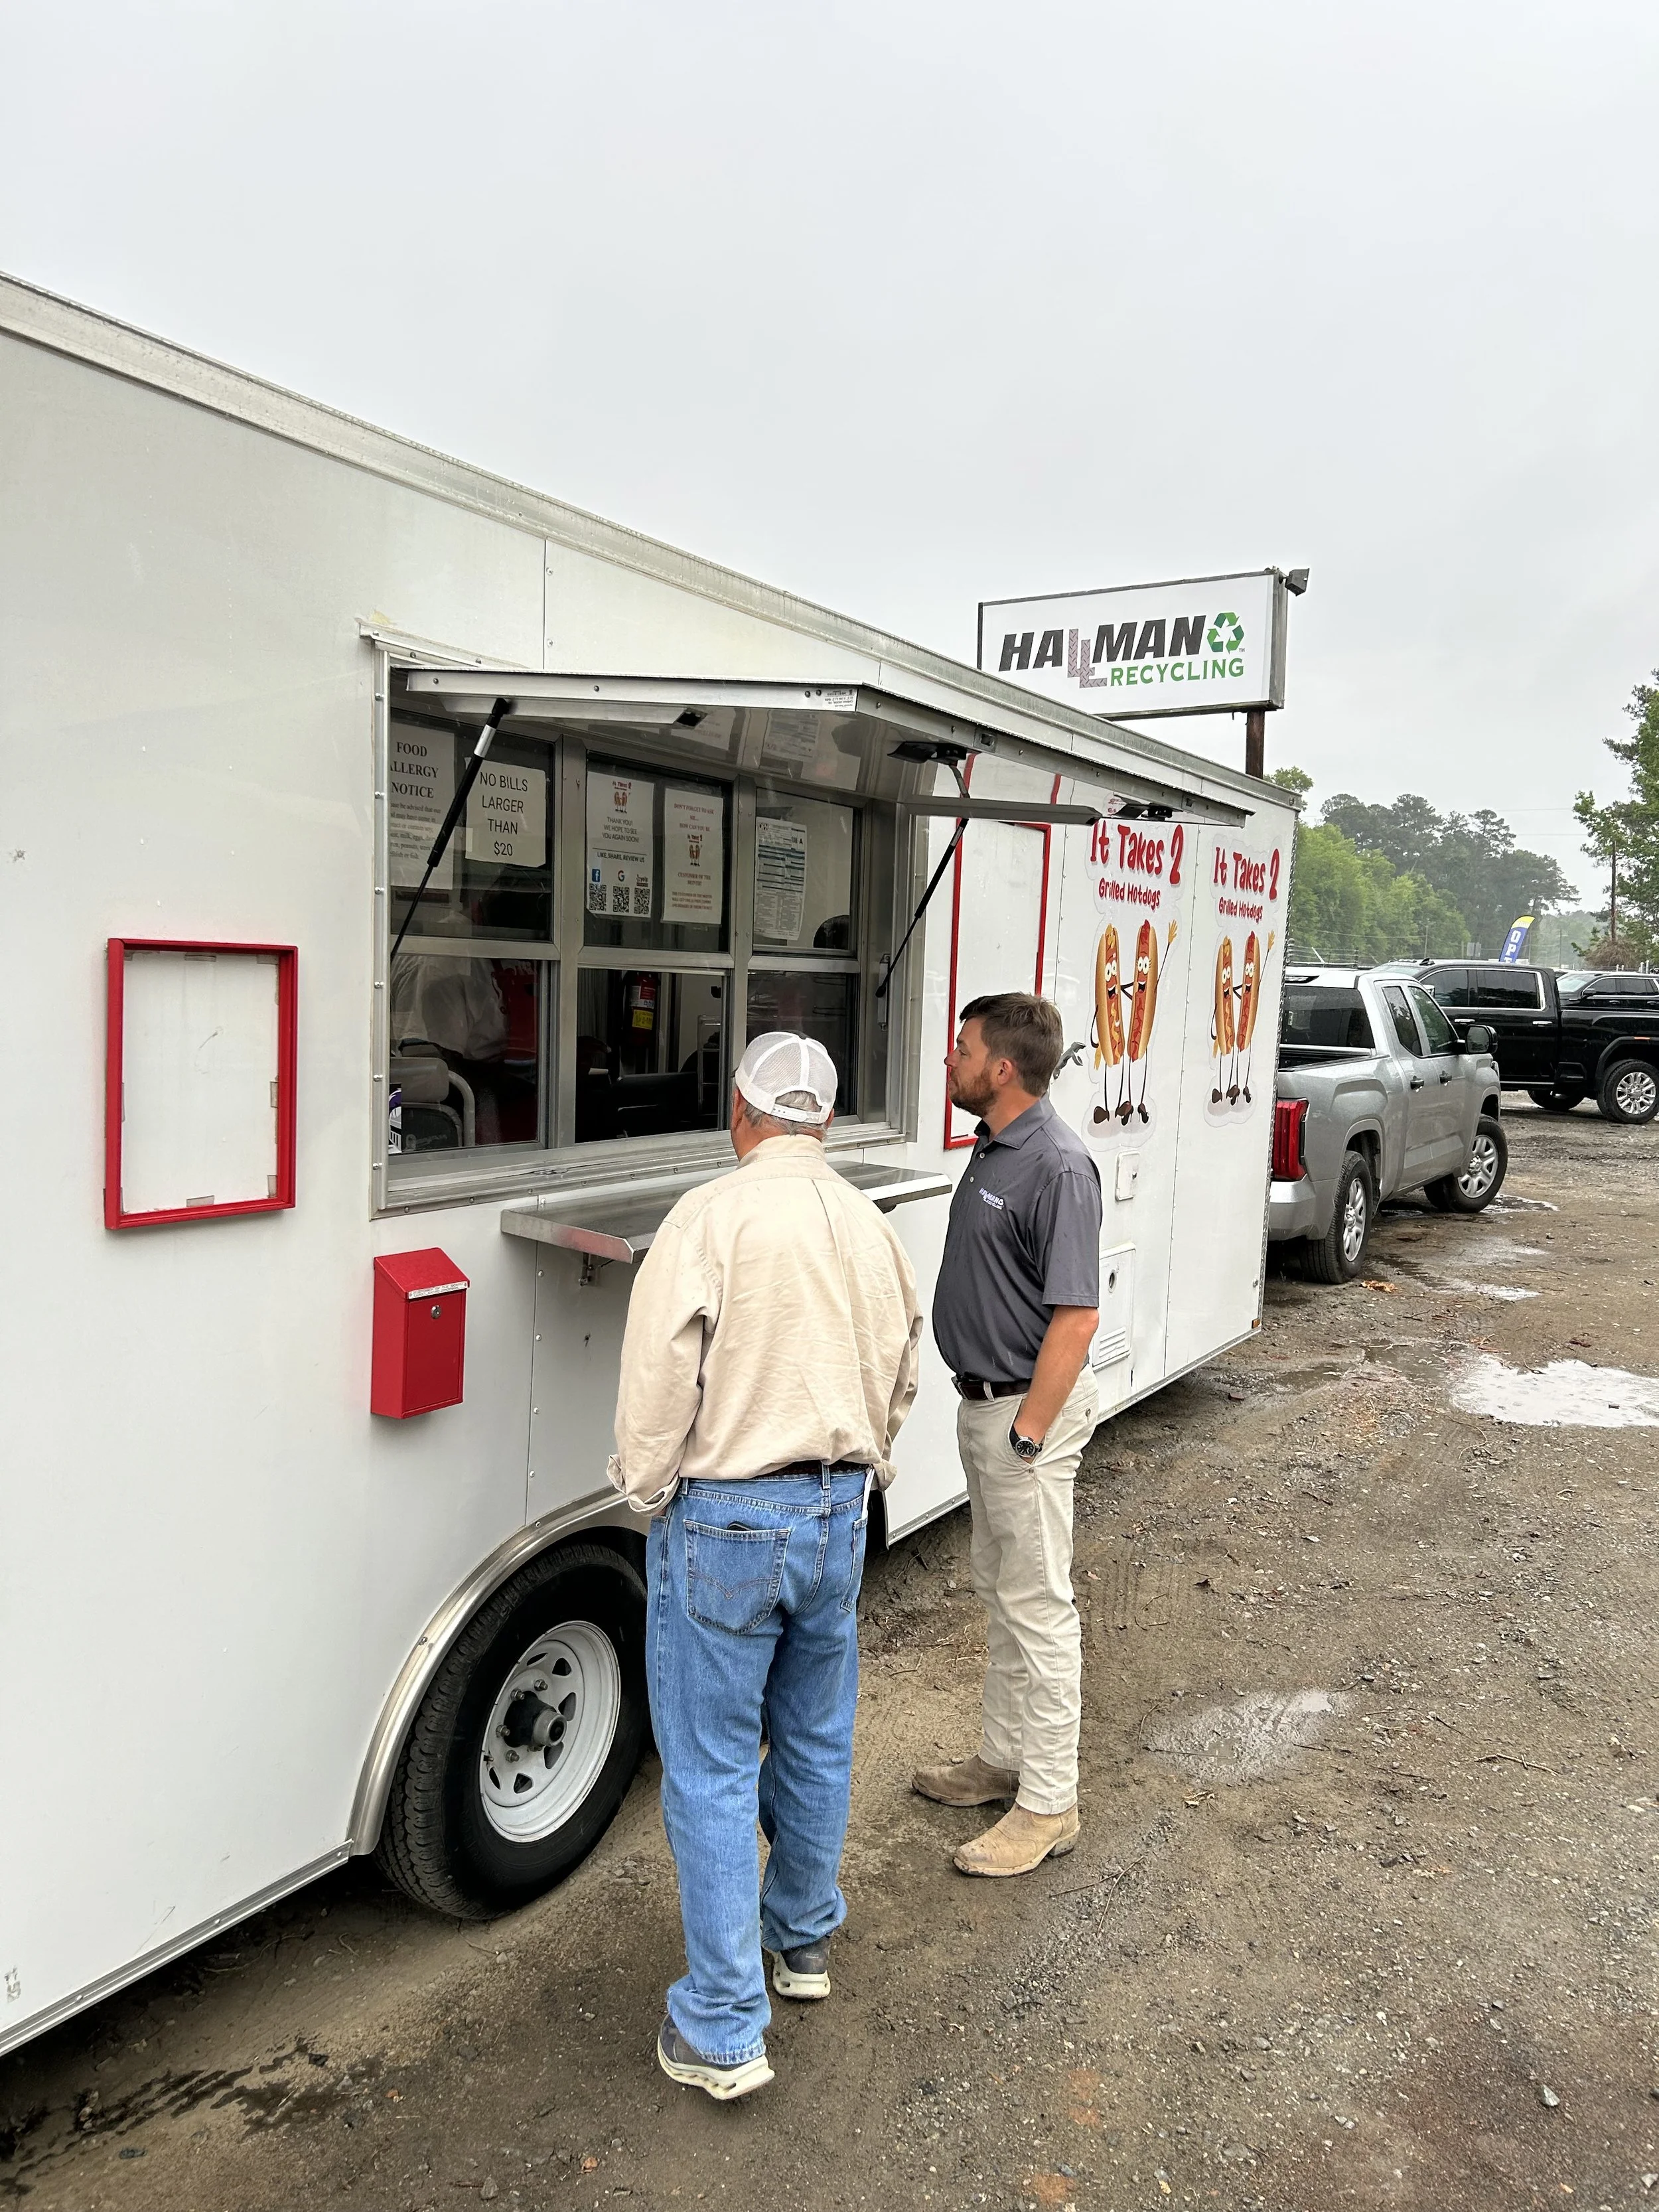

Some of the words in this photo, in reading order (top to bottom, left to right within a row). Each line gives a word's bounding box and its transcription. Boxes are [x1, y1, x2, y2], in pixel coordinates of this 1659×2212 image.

[999, 615, 1206, 688] HALLMAN
[1110, 658, 1244, 686] RECYCLING
[396, 741, 427, 757] FOOD
[392, 781, 434, 798] NOTICE
[480, 771, 496, 786] NO
[500, 775, 528, 792] BILLS
[482, 795, 524, 814] LARGER
[488, 818, 518, 835] THAN
[494, 840, 513, 856] $20
[1090, 820, 1109, 864] It
[1118, 824, 1165, 875] Takes
[1169, 824, 1183, 884] 2
[1214, 847, 1227, 885] It
[1233, 851, 1265, 893] Takes
[1269, 848, 1279, 900] 2
[1099, 877, 1125, 901] Grilled
[1127, 882, 1161, 911] Hotdogs
[1219, 897, 1238, 916] Grilled
[1238, 900, 1263, 923] Hotdogs
